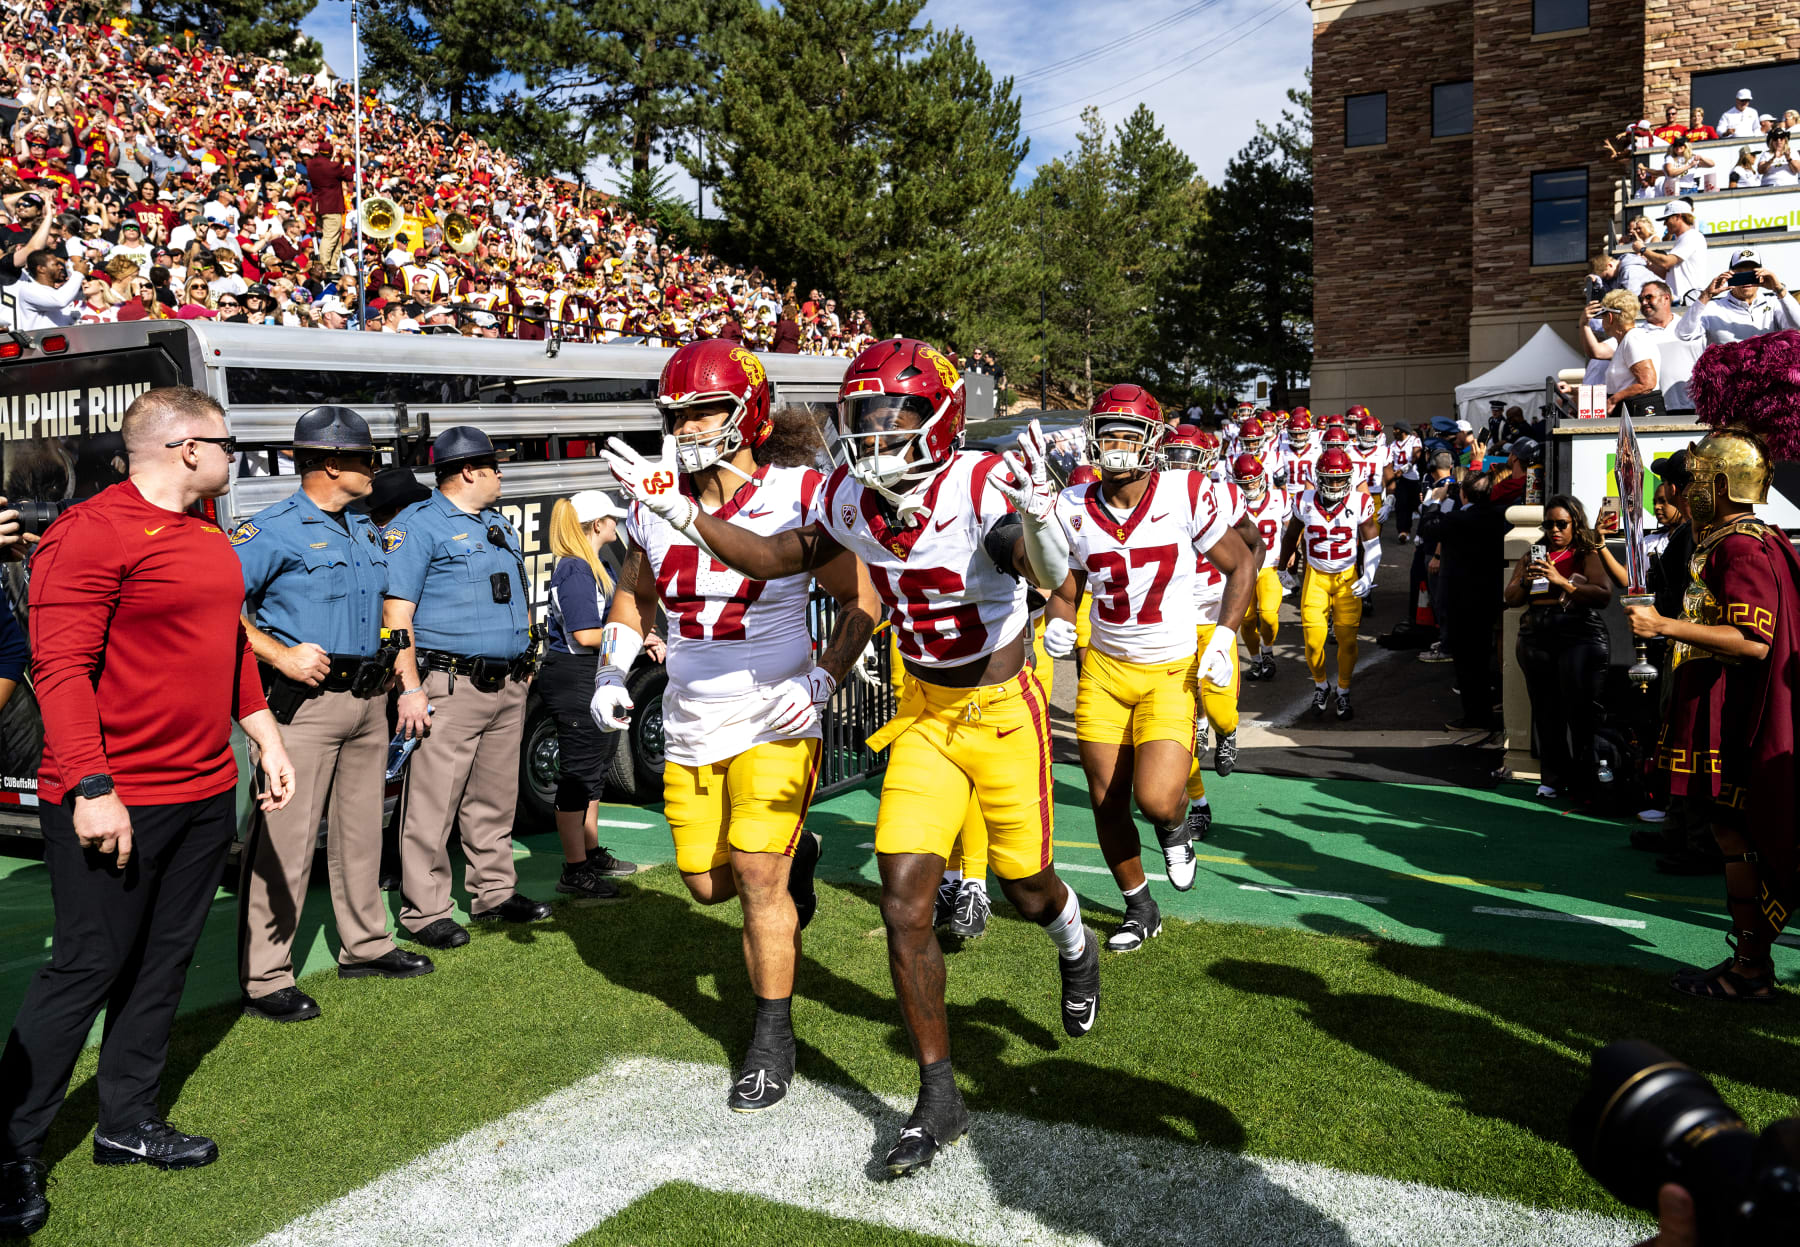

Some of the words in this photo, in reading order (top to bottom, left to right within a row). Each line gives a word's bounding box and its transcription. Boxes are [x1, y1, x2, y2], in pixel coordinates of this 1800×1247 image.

[138, 212, 163, 224] USC
[0, 389, 81, 440] ALPHIE
[88, 382, 150, 434] RUN
[643, 470, 674, 495] SC
[1307, 525, 1352, 560] 22
[1086, 543, 1178, 625] 37
